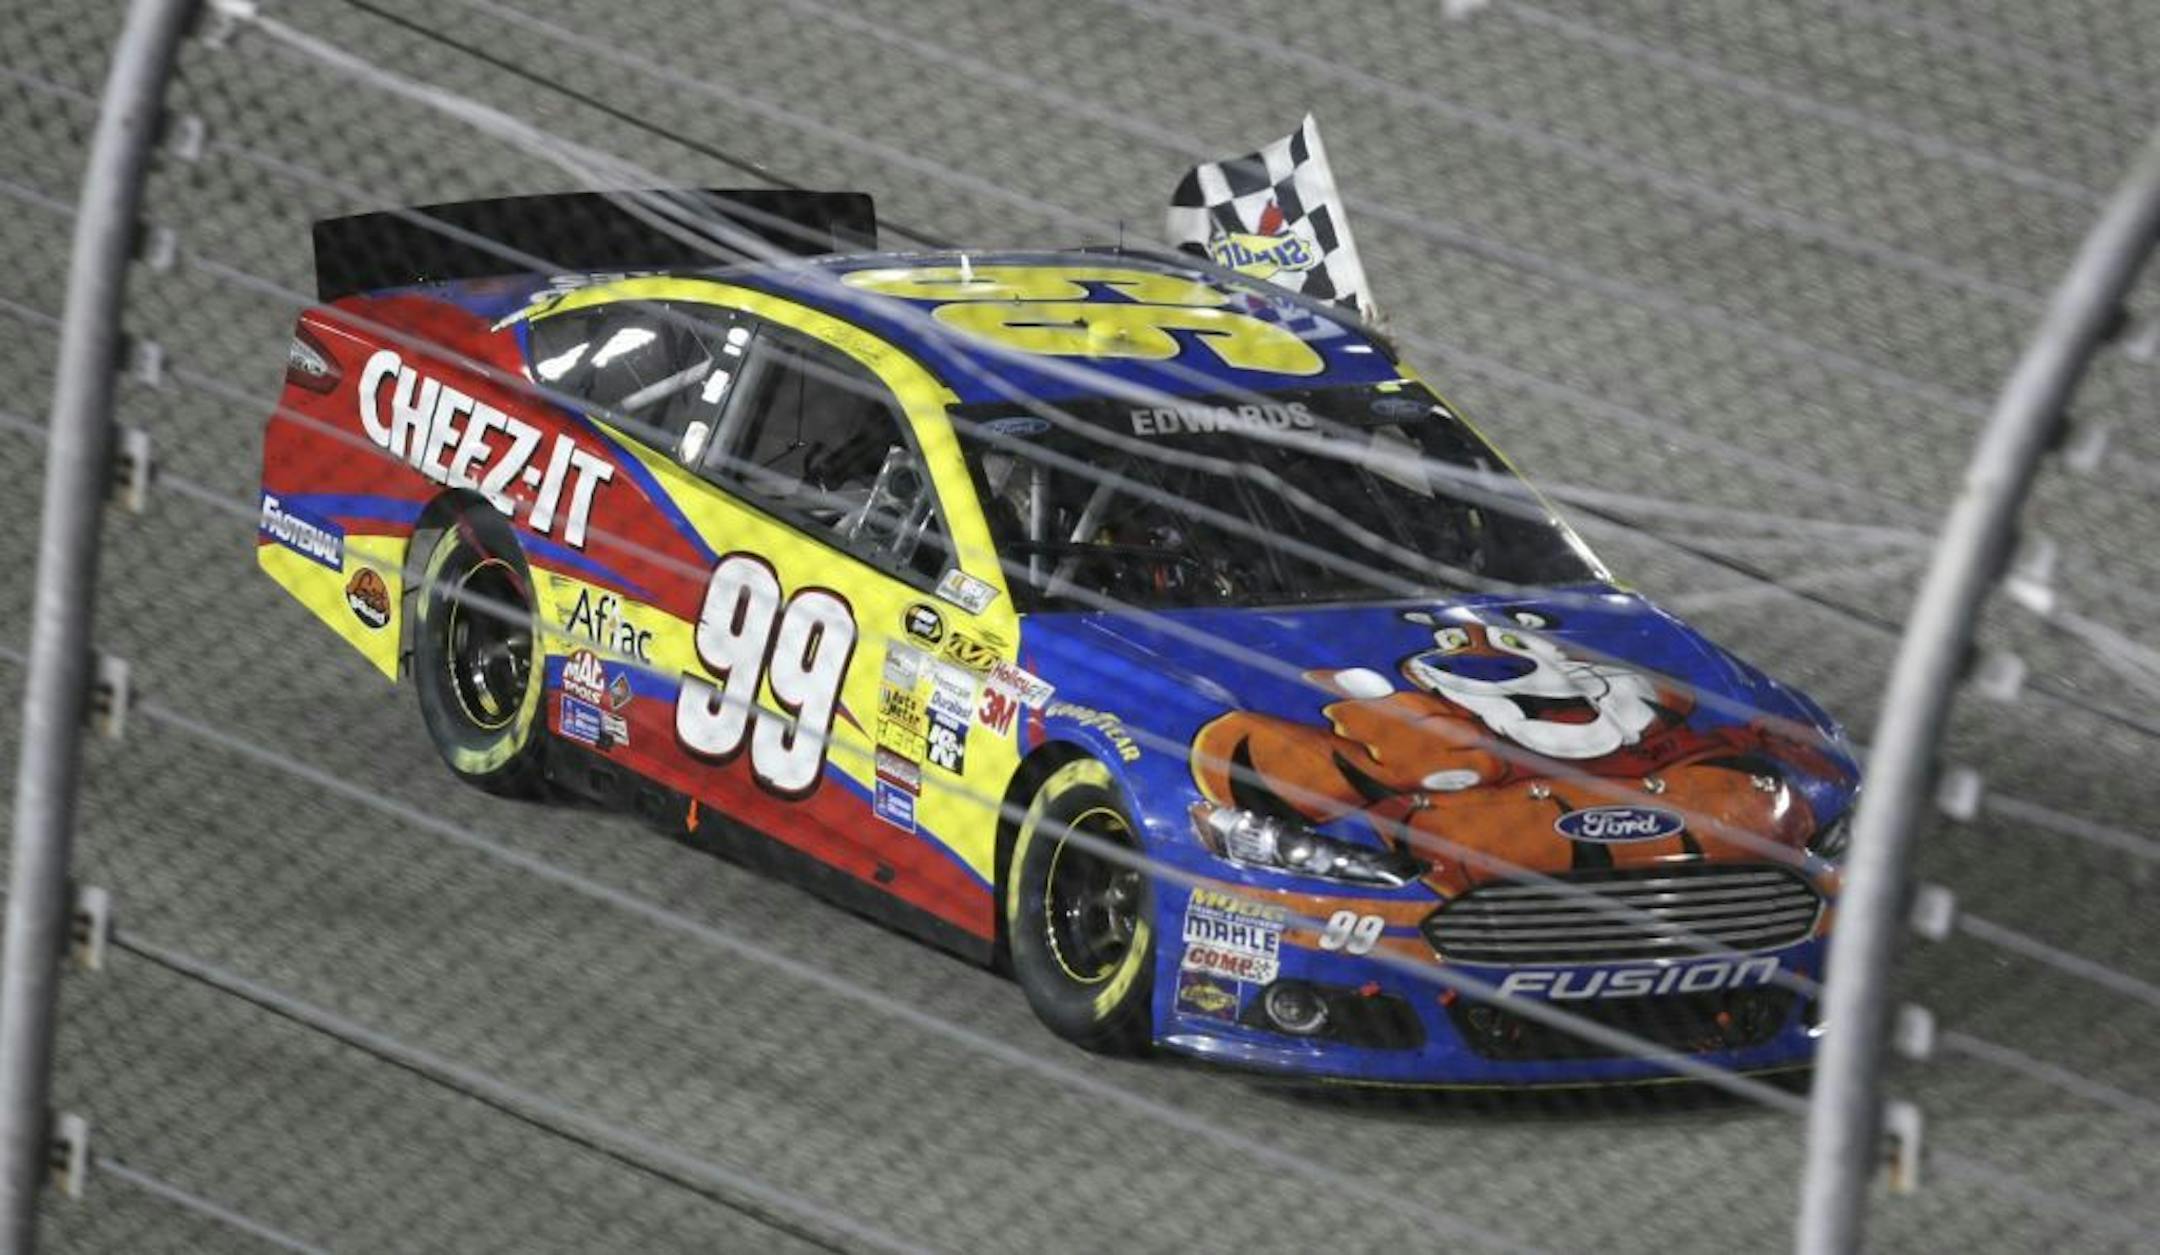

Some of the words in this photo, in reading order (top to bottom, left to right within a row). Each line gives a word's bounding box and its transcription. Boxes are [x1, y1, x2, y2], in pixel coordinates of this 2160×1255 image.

[1130, 402, 1315, 436] EDWARDS
[359, 349, 614, 549] CHEEZ-IT
[675, 551, 859, 801] 99
[978, 687, 1018, 736] 3M
[1577, 806, 1665, 840] Ford
[1187, 914, 1278, 953] MAHLE
[1318, 910, 1385, 955] 99
[1496, 957, 1783, 1001] FUSION
